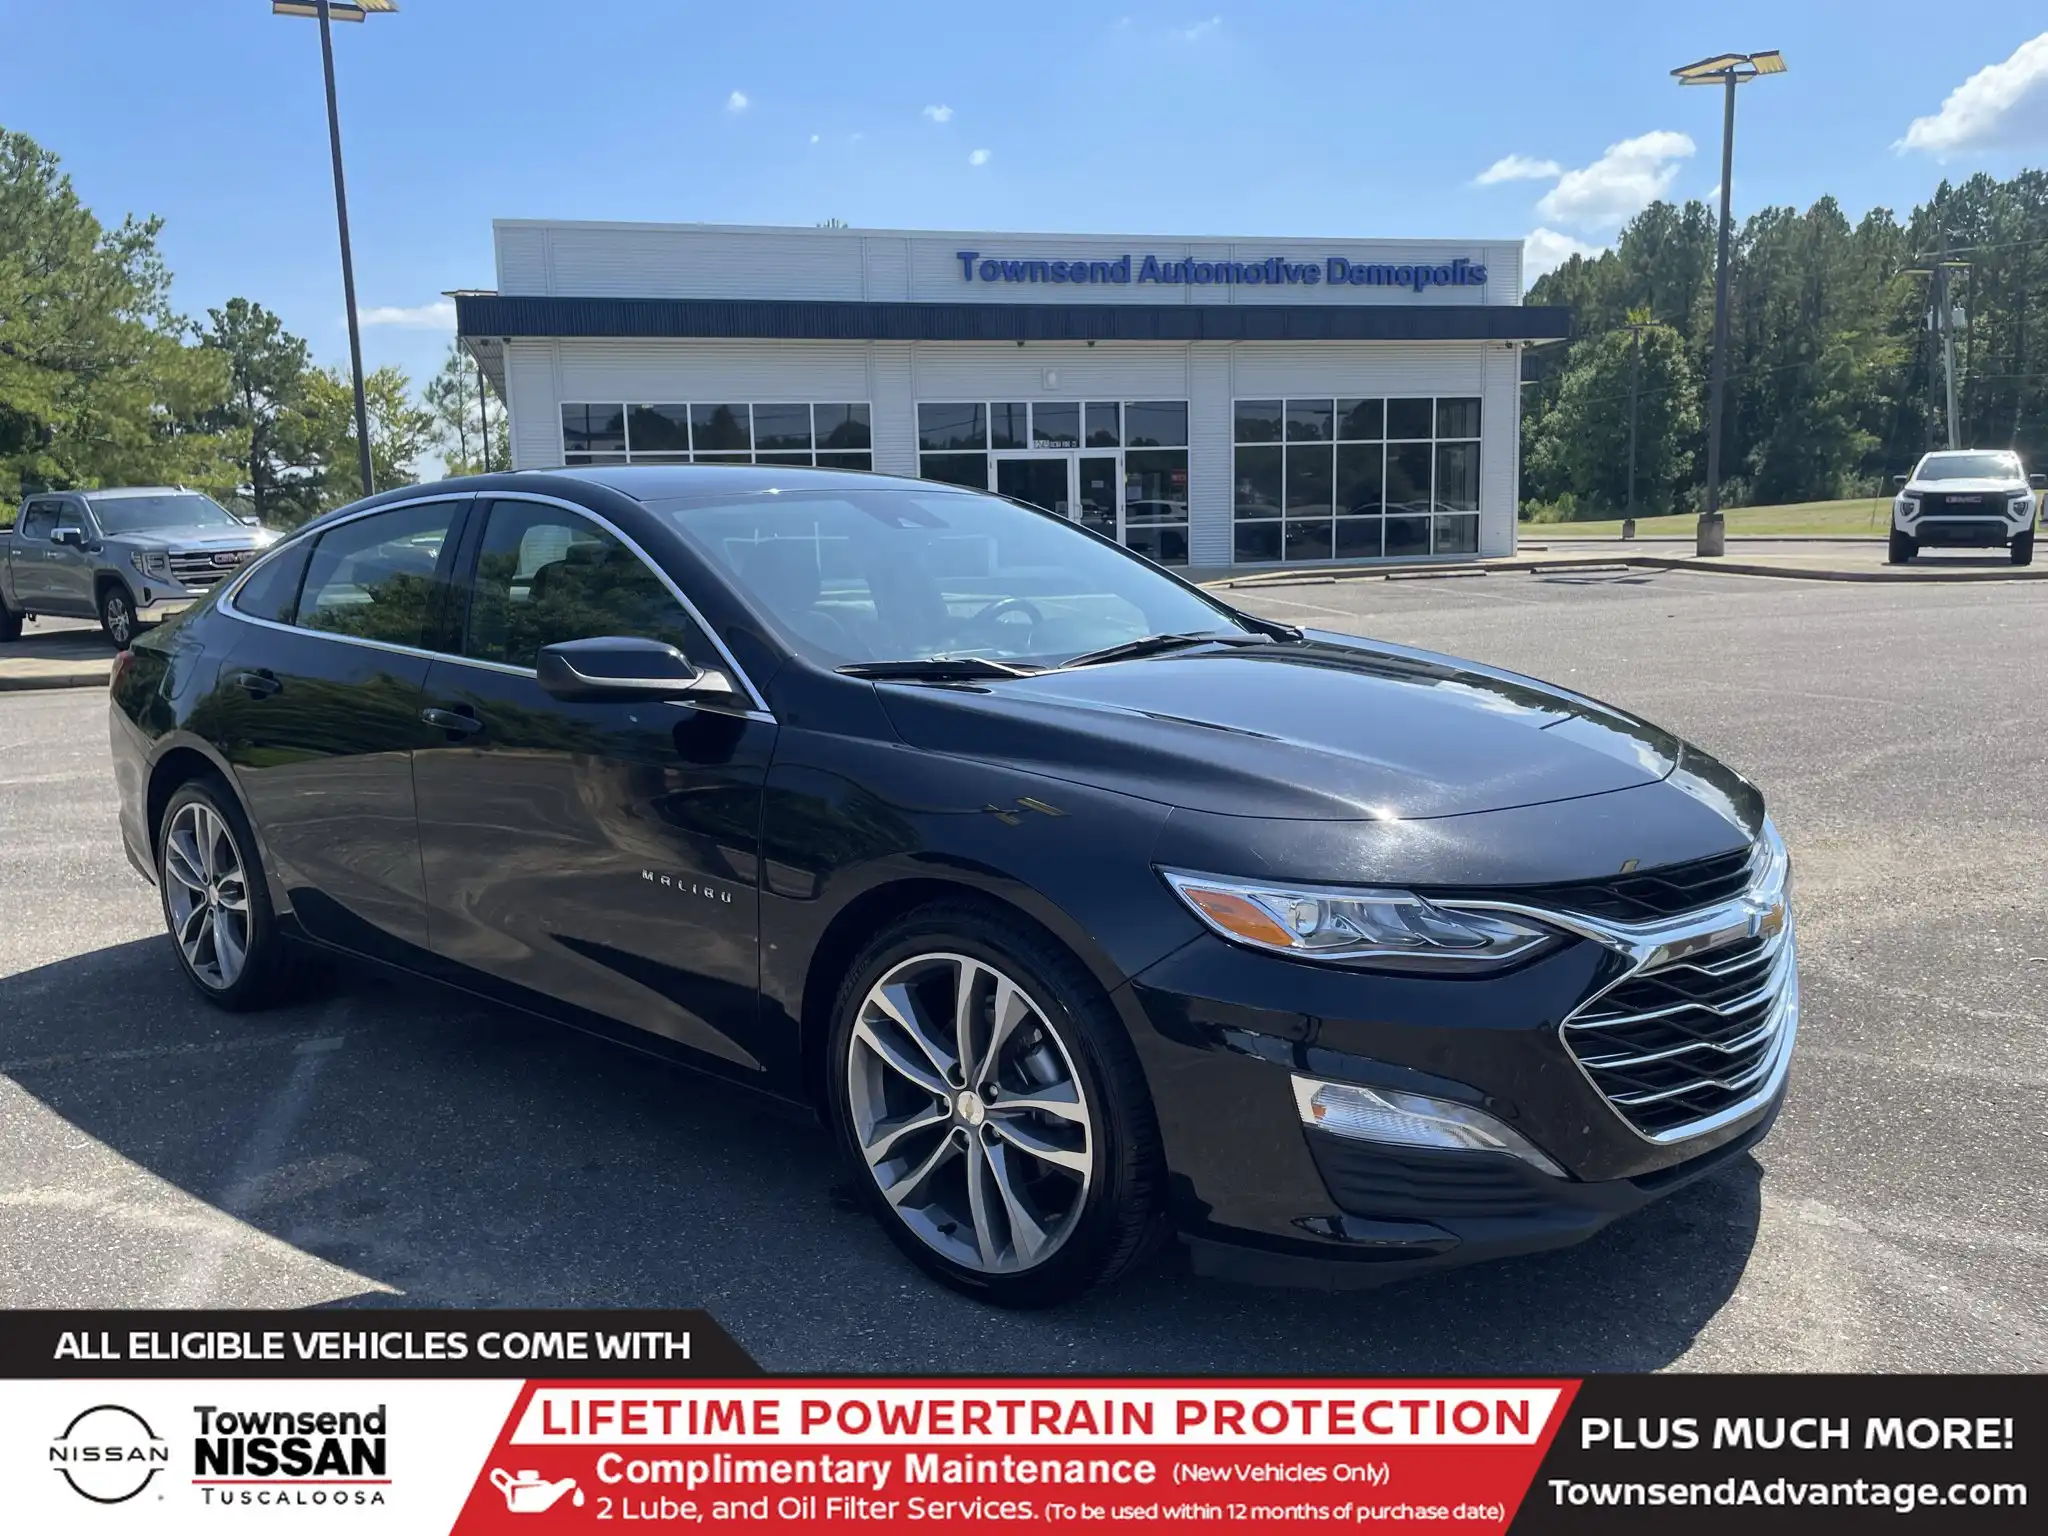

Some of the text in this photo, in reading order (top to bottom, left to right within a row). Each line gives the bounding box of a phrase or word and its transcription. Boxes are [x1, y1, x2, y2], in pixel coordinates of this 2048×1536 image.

[957, 252, 1487, 292] Townsend Automotive Demopolis
[1945, 495, 1982, 504] GMC
[642, 869, 732, 903] MALIBU
